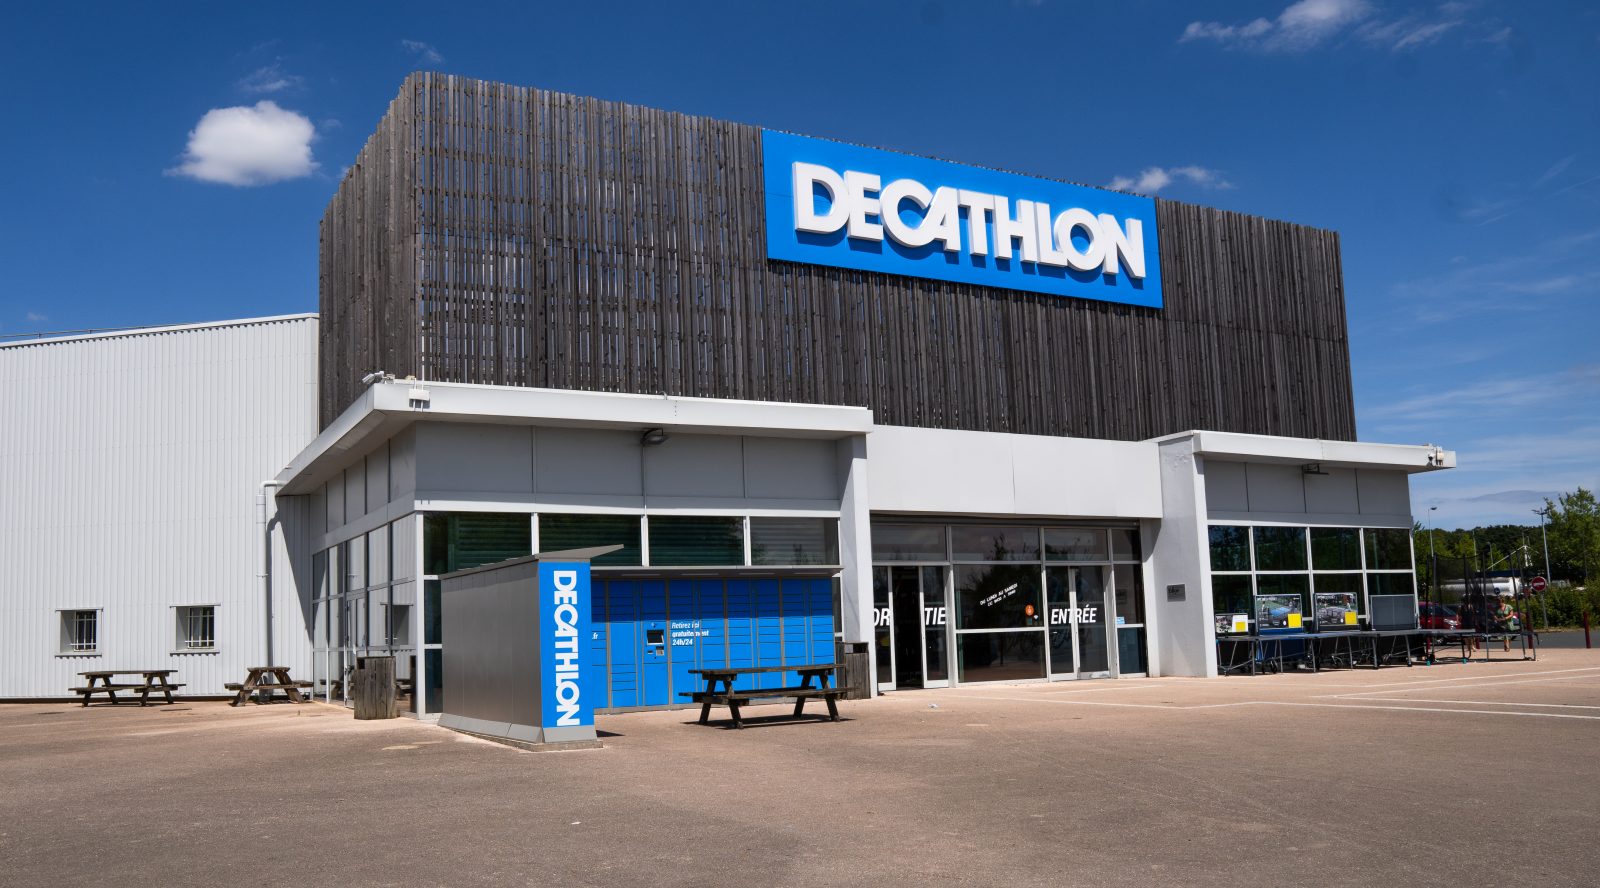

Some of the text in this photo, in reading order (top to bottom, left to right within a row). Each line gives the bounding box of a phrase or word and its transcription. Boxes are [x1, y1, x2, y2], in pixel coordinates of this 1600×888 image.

[792, 161, 1146, 279] DECATHLON
[553, 570, 580, 727] DECATHLON
[671, 630, 710, 638] gratuitement
[1051, 604, 1097, 624] ENTRÉE
